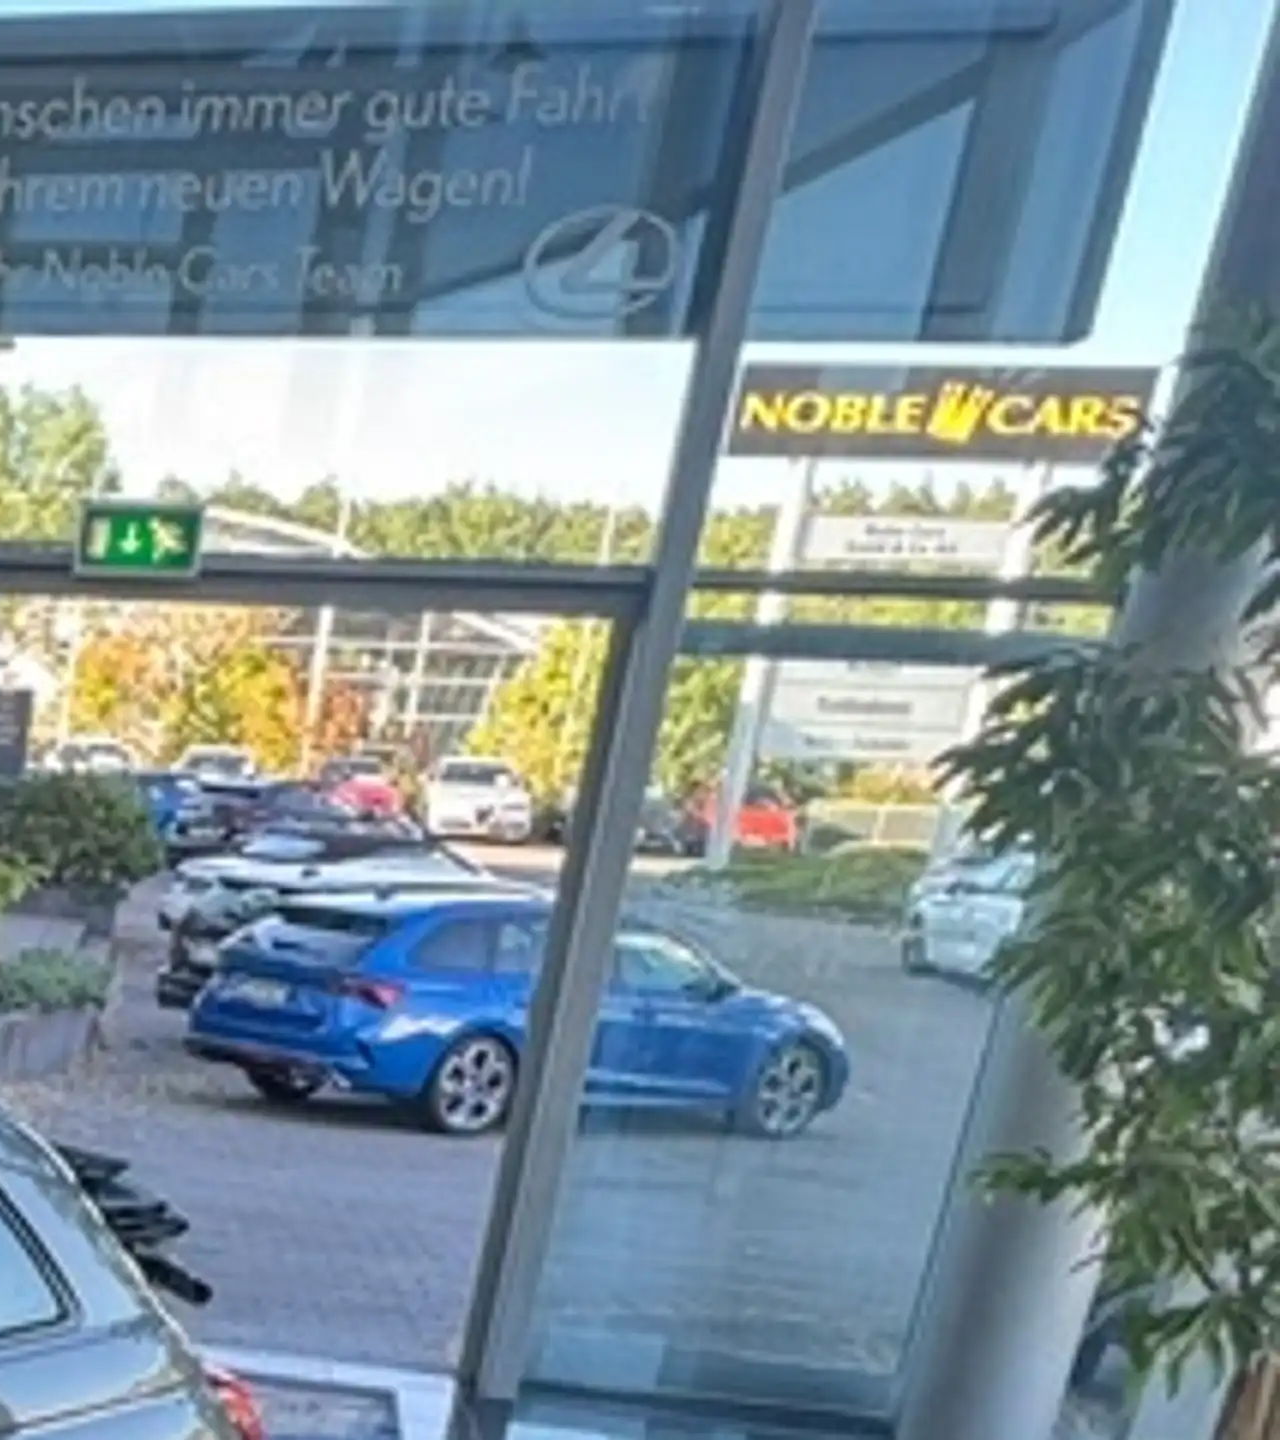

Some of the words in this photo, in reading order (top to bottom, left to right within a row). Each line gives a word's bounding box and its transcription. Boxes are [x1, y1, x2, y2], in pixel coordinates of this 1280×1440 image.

[179, 78, 352, 138] immer
[363, 74, 492, 143] gute
[138, 163, 306, 213] neuen
[320, 145, 534, 224] Wagen!
[41, 246, 171, 292] Noble
[178, 244, 278, 295] Cars
[296, 244, 404, 296] Team
[740, 392, 930, 436] NOBLE
[985, 394, 1139, 437] CARS
